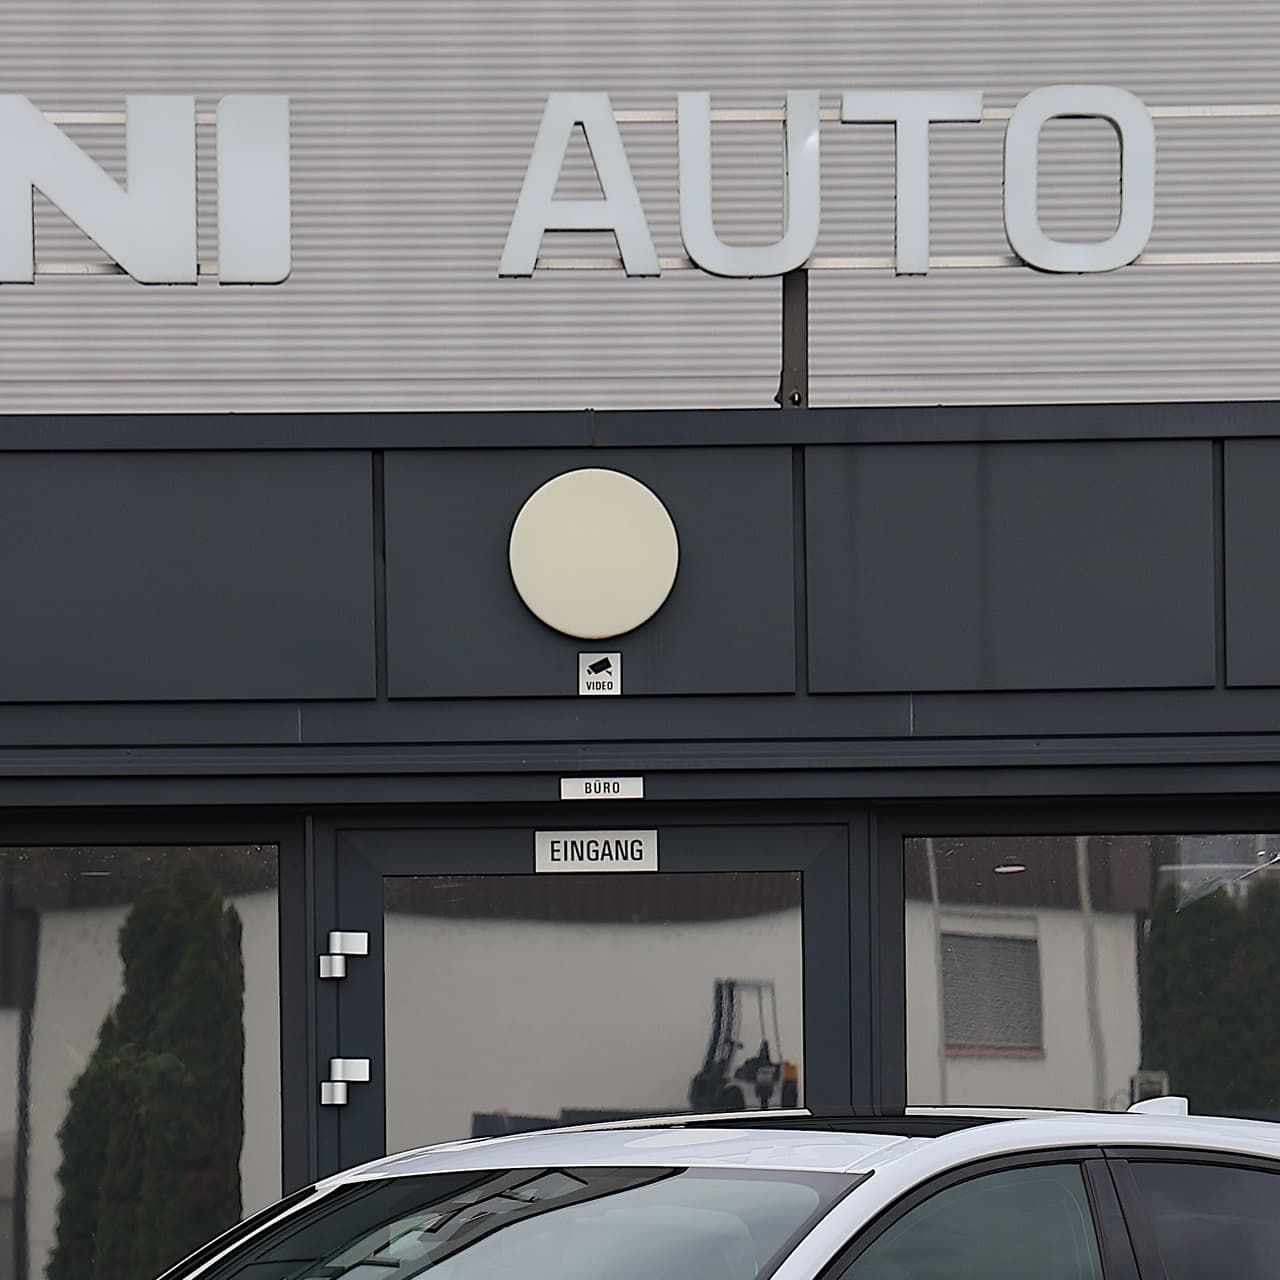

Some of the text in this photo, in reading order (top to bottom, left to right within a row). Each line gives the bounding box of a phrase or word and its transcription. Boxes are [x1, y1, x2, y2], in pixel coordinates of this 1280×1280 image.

[497, 83, 1157, 278] AUTO
[586, 681, 614, 691] VIDEO
[584, 780, 621, 794] BÜRO
[550, 839, 644, 862] EINGANG
